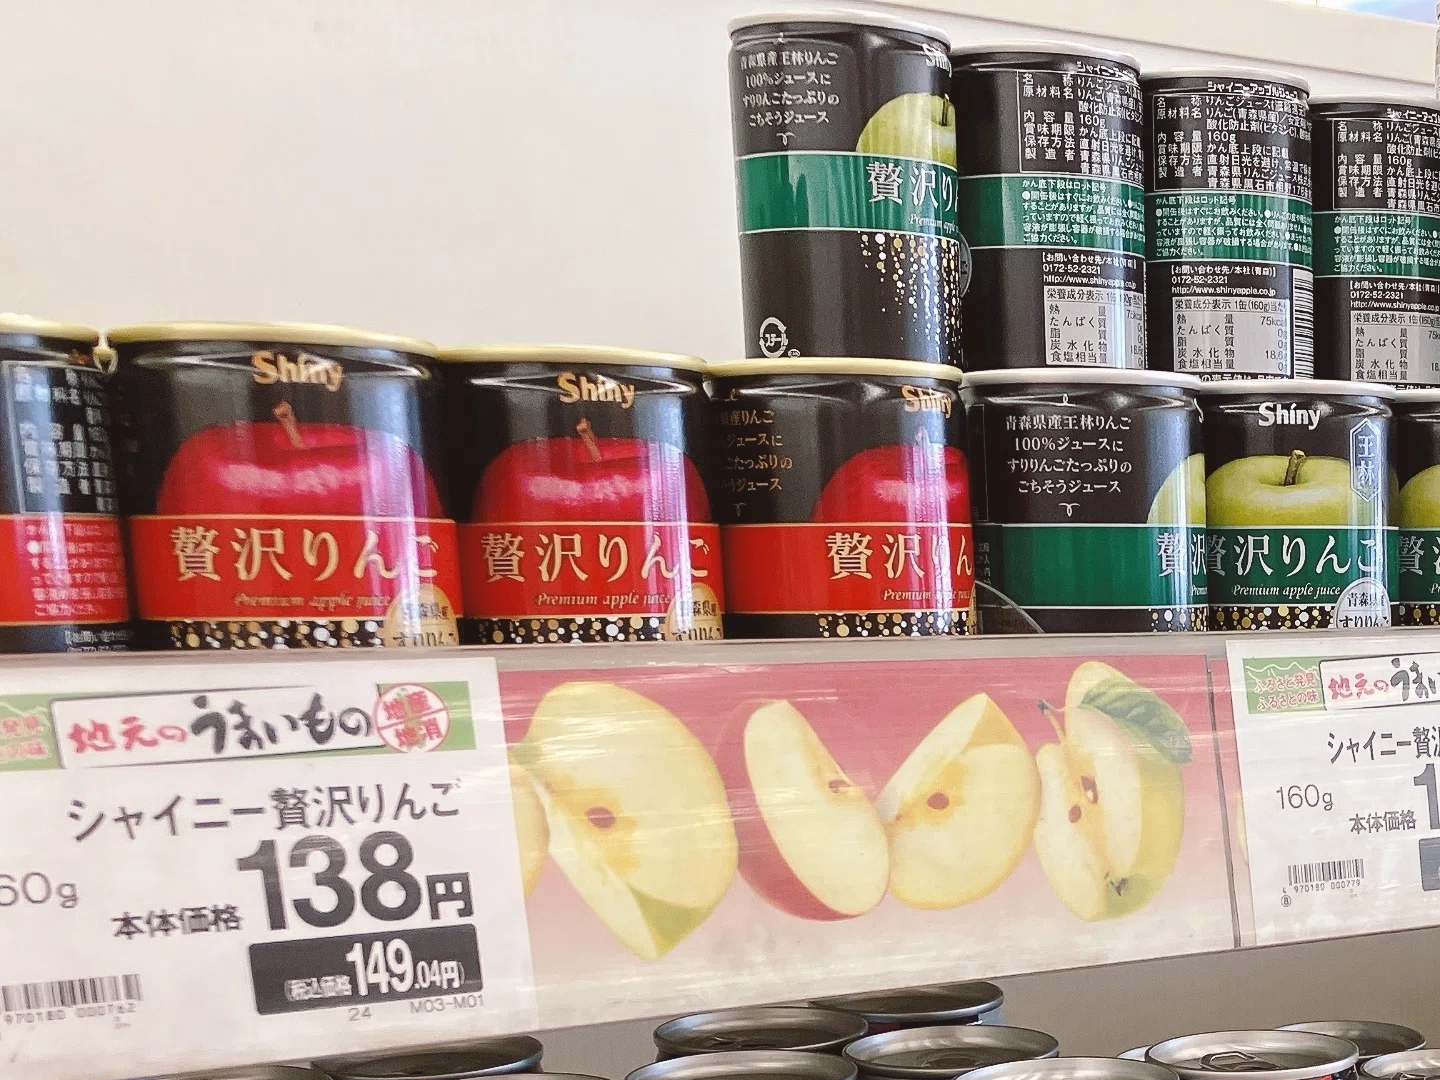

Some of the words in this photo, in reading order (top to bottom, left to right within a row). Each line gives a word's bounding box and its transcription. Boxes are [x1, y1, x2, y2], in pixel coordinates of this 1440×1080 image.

[744, 71, 831, 88] 100%ジュースに
[749, 112, 830, 126] ごちそうジュース
[1207, 131, 1236, 144] 160g
[1043, 264, 1100, 274] 0172-52-2321
[1171, 276, 1228, 284] 0172-52-2321
[1172, 285, 1276, 296] http://www.shinyapple.co.jp
[1350, 290, 1403, 299] 0172-52-2321
[557, 371, 635, 409] Shiny
[1005, 415, 1131, 431] 青森県産王林りんご
[1257, 402, 1321, 431] Shiny
[1014, 437, 1124, 452] 100%ジュースに
[1007, 458, 1132, 474] すりりんごたっぷりの
[1018, 479, 1121, 494] ごちそうジュース
[171, 527, 438, 582] 贅沢りんご
[481, 532, 710, 582] 贅沢りんご
[1232, 584, 1280, 596] Premium
[1282, 584, 1312, 599] apple
[1315, 584, 1342, 599] juice
[535, 592, 599, 607] Premium
[602, 593, 638, 608] apple
[1255, 672, 1317, 692] ふるさと発見
[1257, 691, 1319, 709] ふるさとの味
[68, 692, 374, 755] 地元のうまいもの
[1276, 785, 1333, 811] 160g
[68, 779, 462, 842] シャイニー贅沢りんご
[1349, 810, 1417, 834] 本体価格
[112, 905, 243, 940] 本体価格
[236, 831, 475, 930] 138円
[349, 1007, 372, 1022] 24
